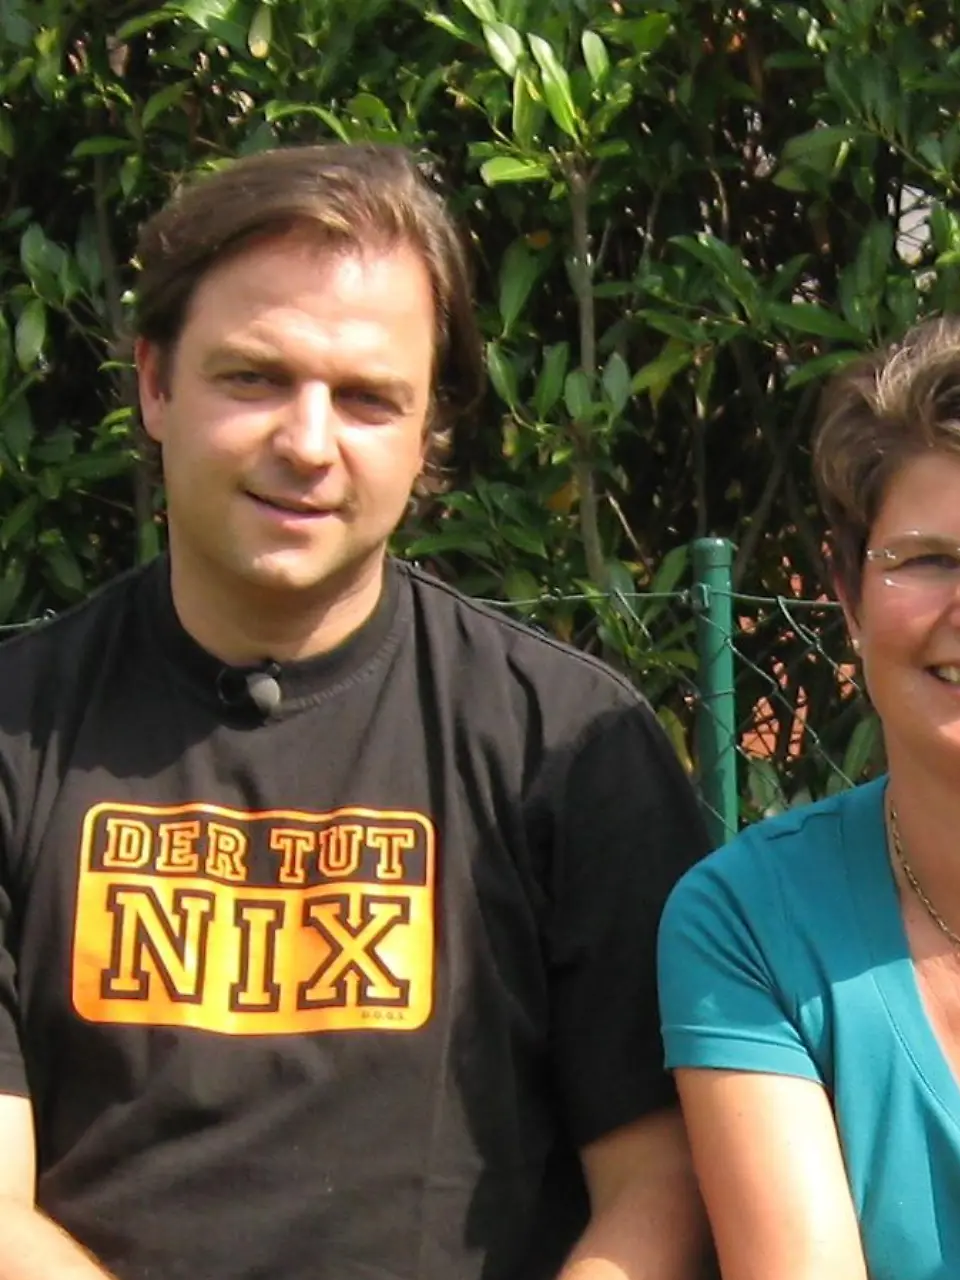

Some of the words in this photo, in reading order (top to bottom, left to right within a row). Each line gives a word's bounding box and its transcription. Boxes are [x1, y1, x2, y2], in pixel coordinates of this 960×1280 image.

[103, 818, 248, 881] DER
[269, 825, 414, 883] TUT
[101, 884, 411, 1012] NIX
